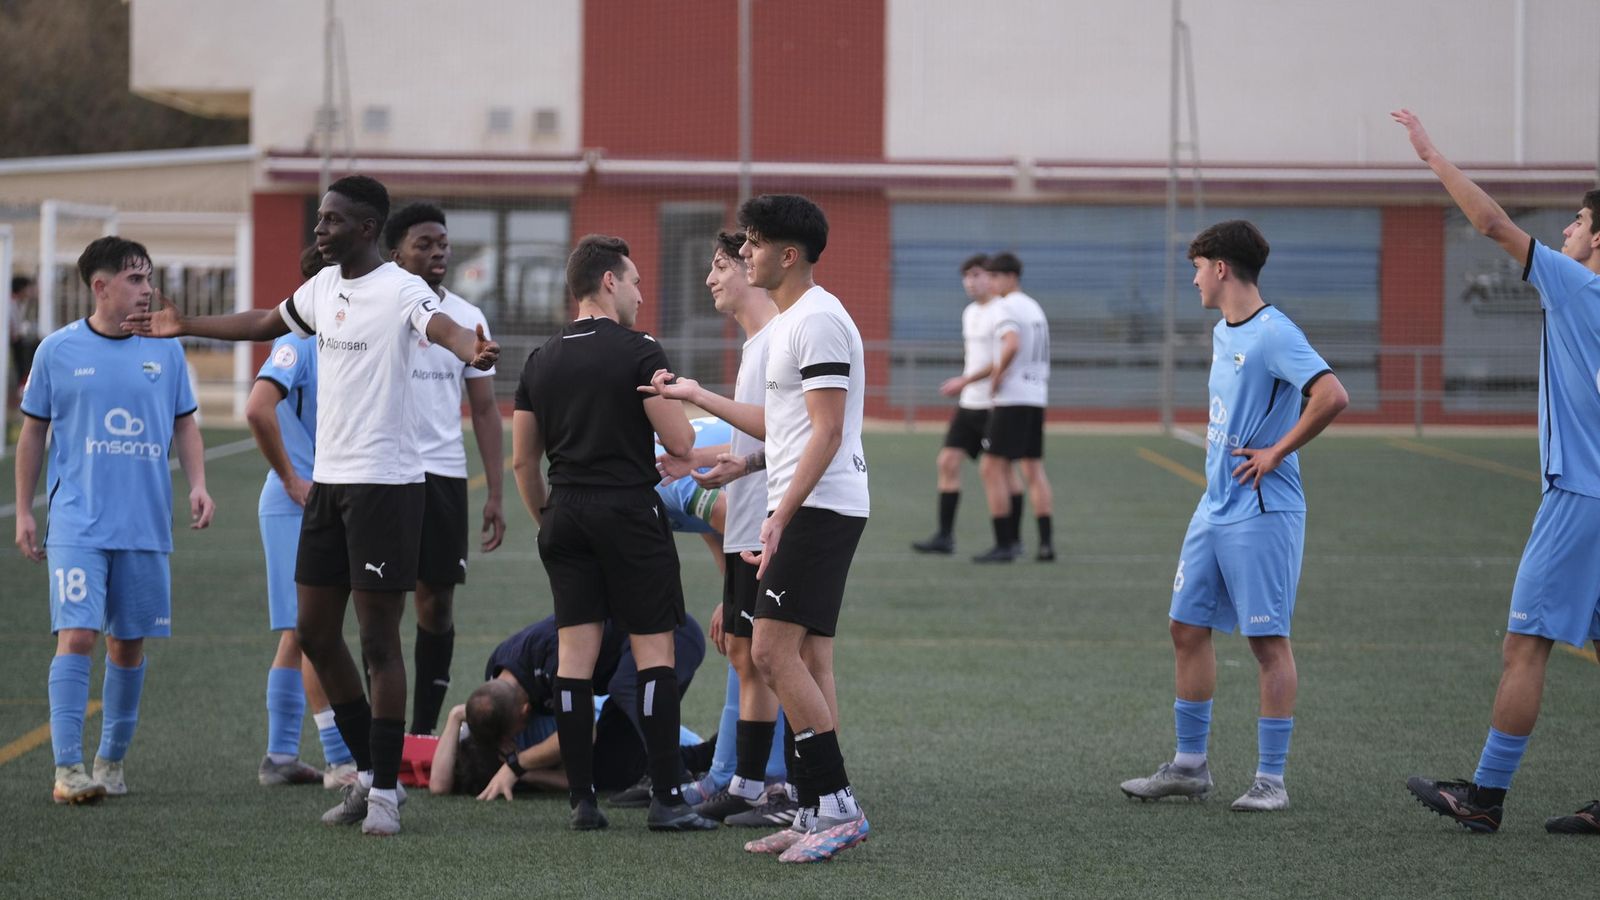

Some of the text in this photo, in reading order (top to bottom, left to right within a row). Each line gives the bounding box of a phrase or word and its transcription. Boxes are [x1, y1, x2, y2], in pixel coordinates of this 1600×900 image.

[325, 338, 368, 352] Alprosan
[73, 367, 97, 377] JAKO
[412, 369, 455, 381] Alprosan
[55, 567, 88, 605] 18
[1250, 615, 1271, 625] JAKO
